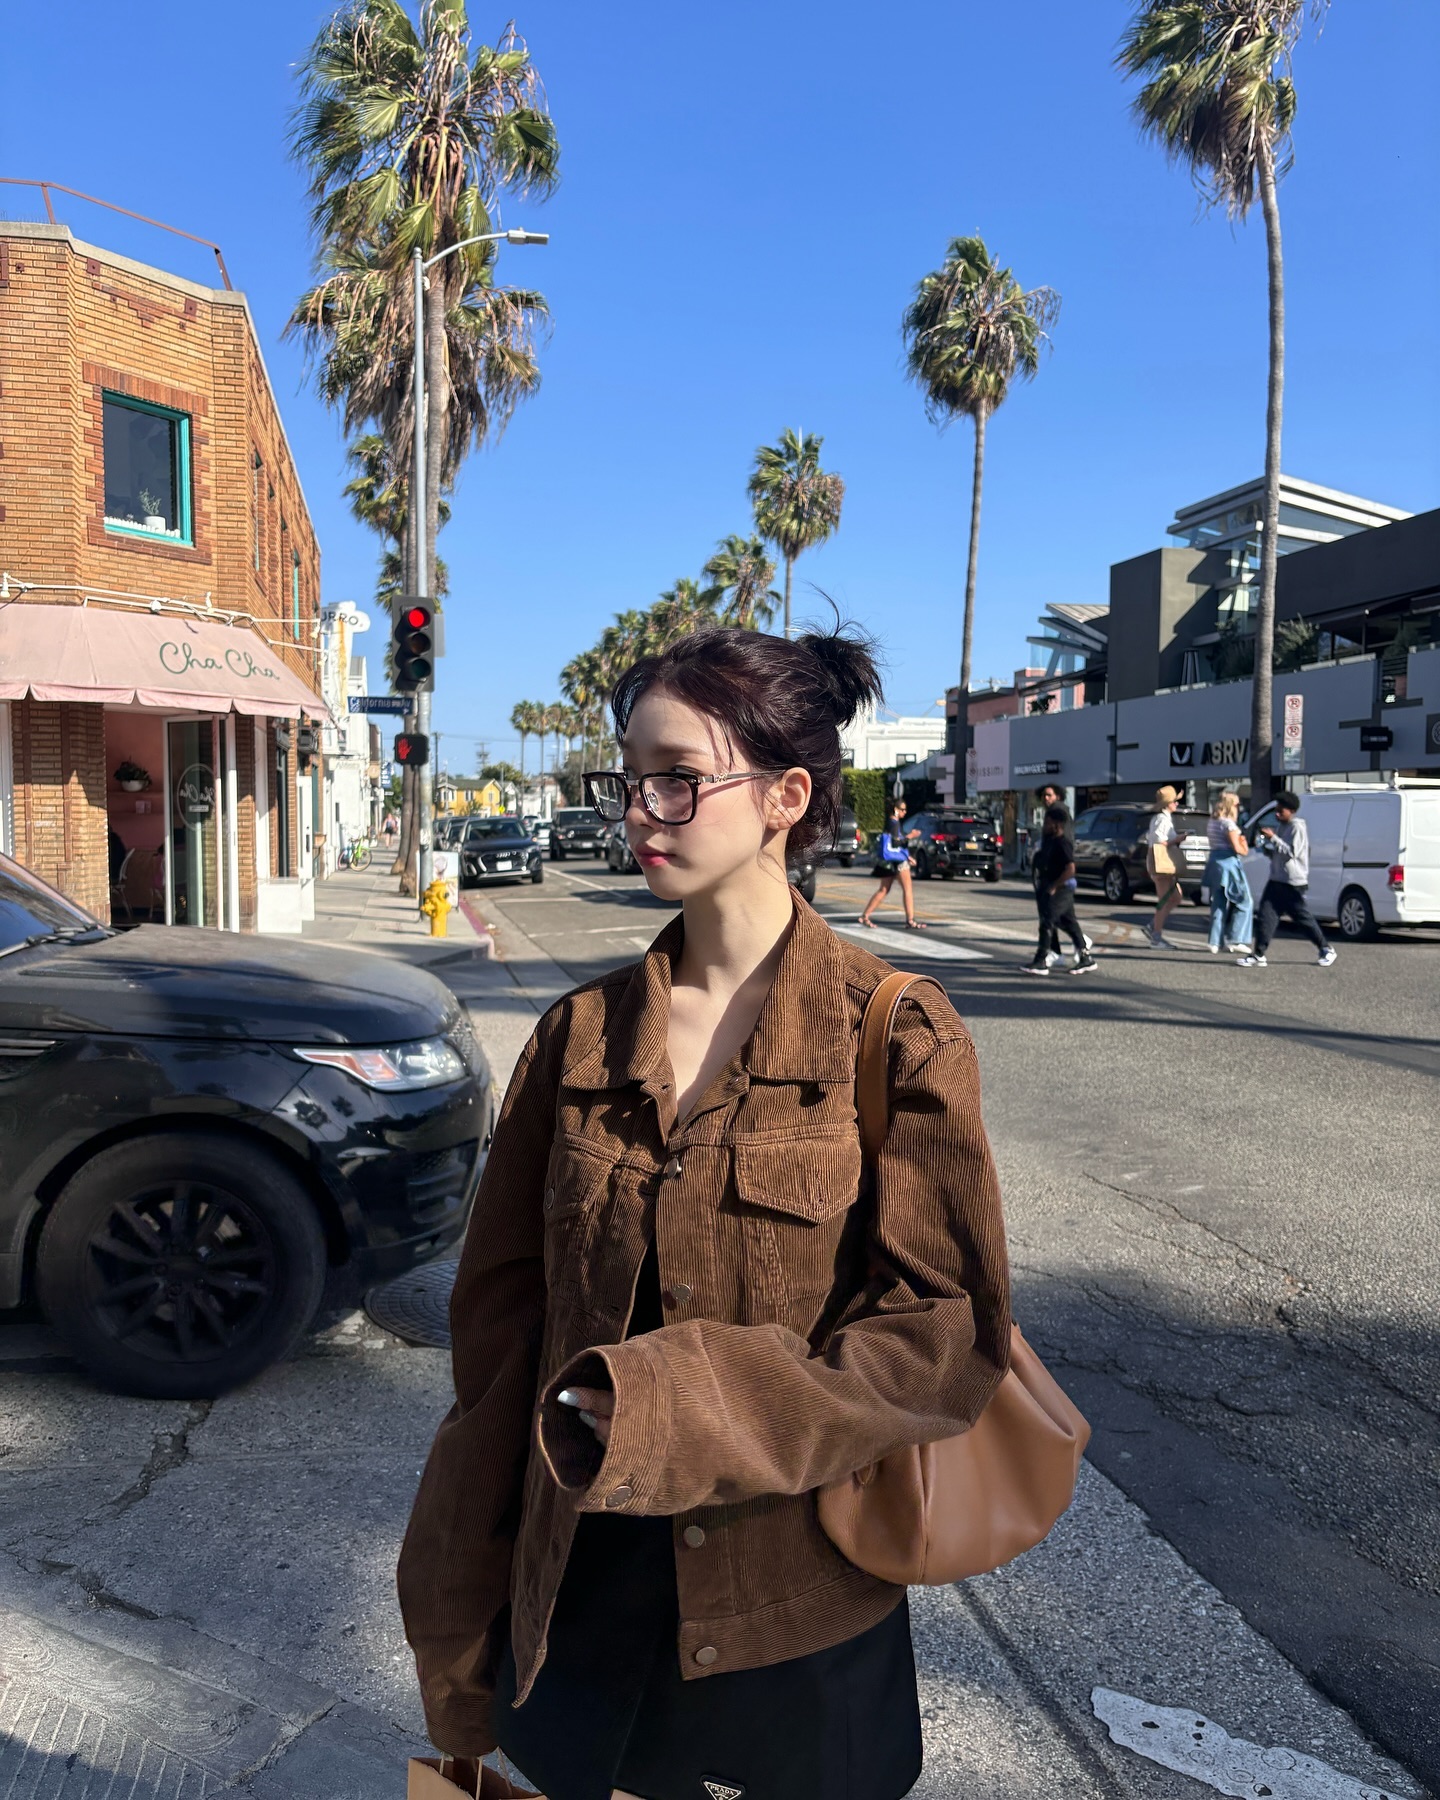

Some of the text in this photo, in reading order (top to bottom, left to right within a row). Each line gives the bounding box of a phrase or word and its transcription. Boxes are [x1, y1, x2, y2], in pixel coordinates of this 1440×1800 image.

[159, 641, 280, 681] Cha Cha
[1201, 738, 1249, 765] ASRV
[710, 1785, 735, 1796] PRADA
